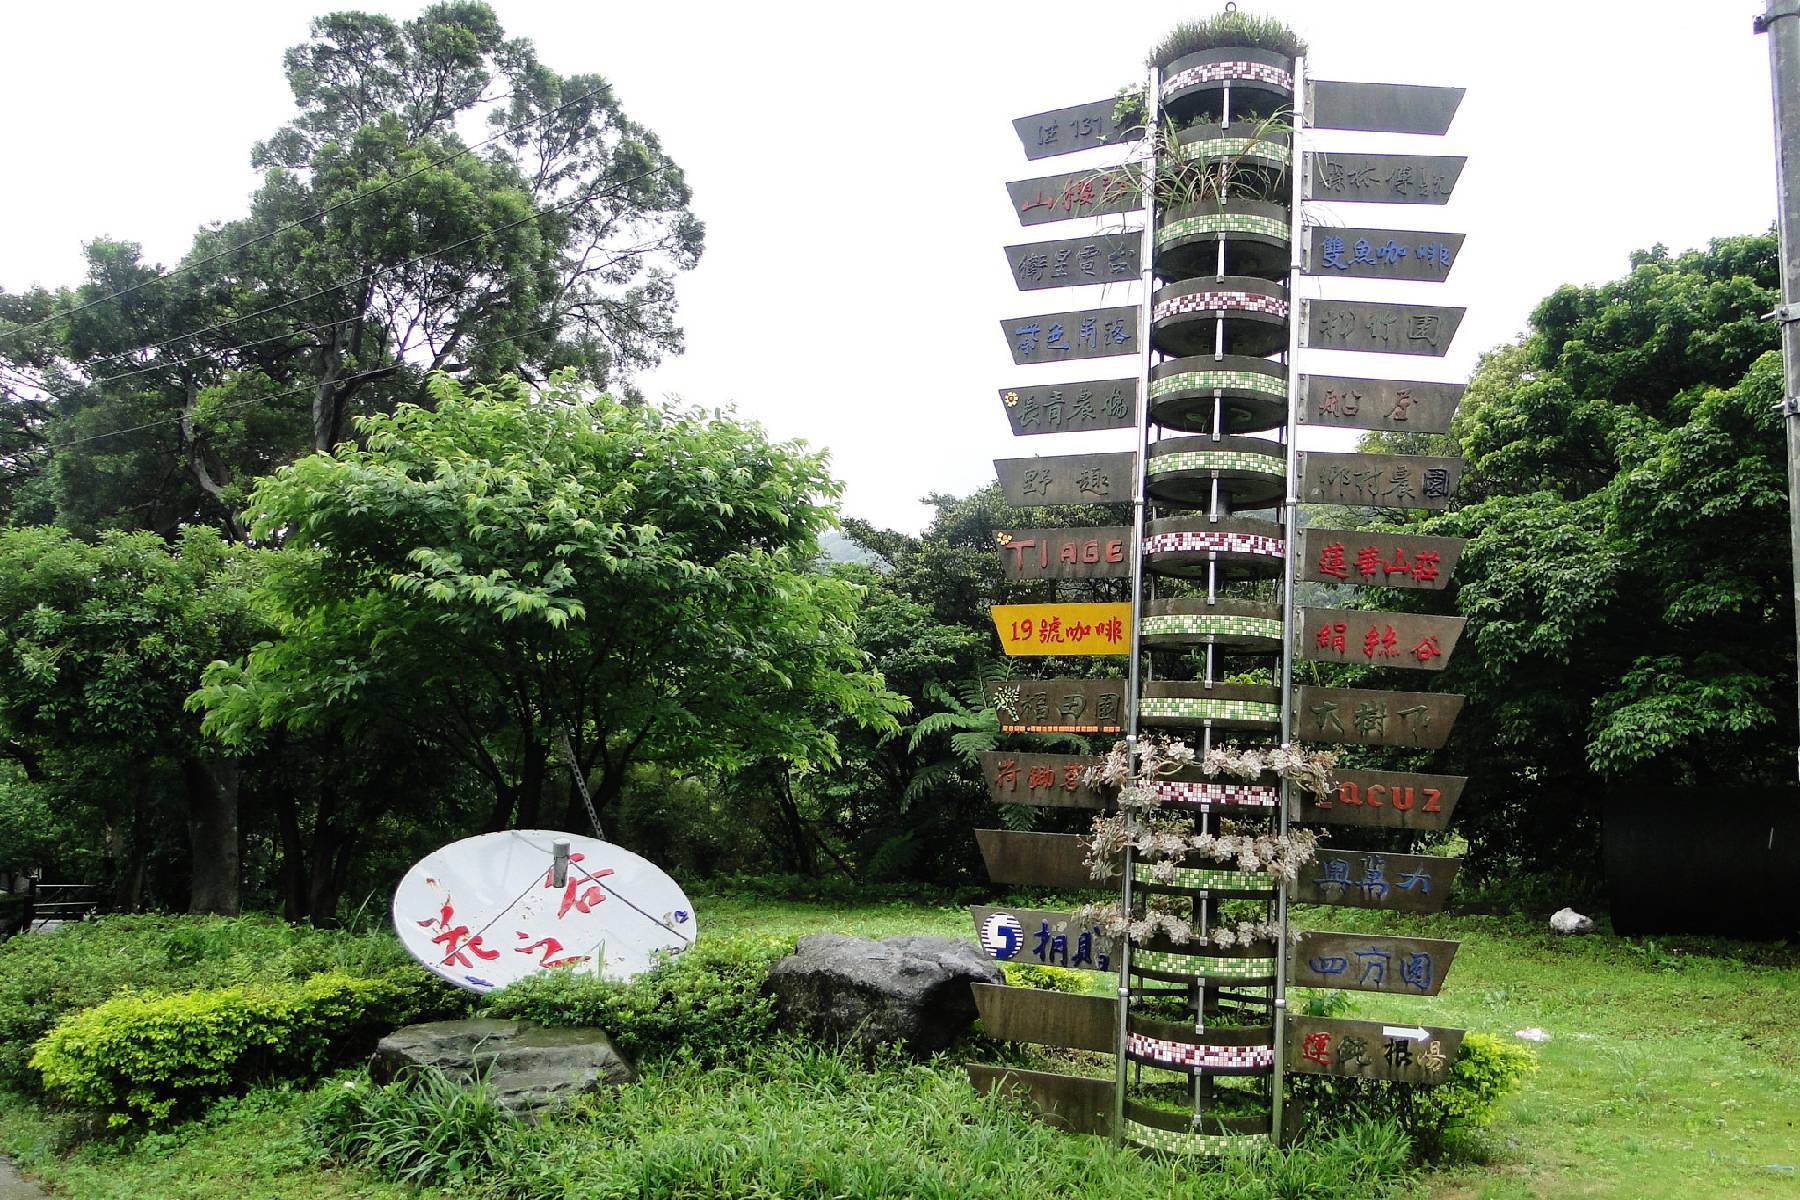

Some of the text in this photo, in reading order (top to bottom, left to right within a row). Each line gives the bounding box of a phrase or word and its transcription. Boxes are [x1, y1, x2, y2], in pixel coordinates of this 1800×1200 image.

[1322, 234, 1451, 271] 雙魚咖啡
[1005, 539, 1124, 571] TIAGE
[1011, 616, 1123, 644] 19號咖啡
